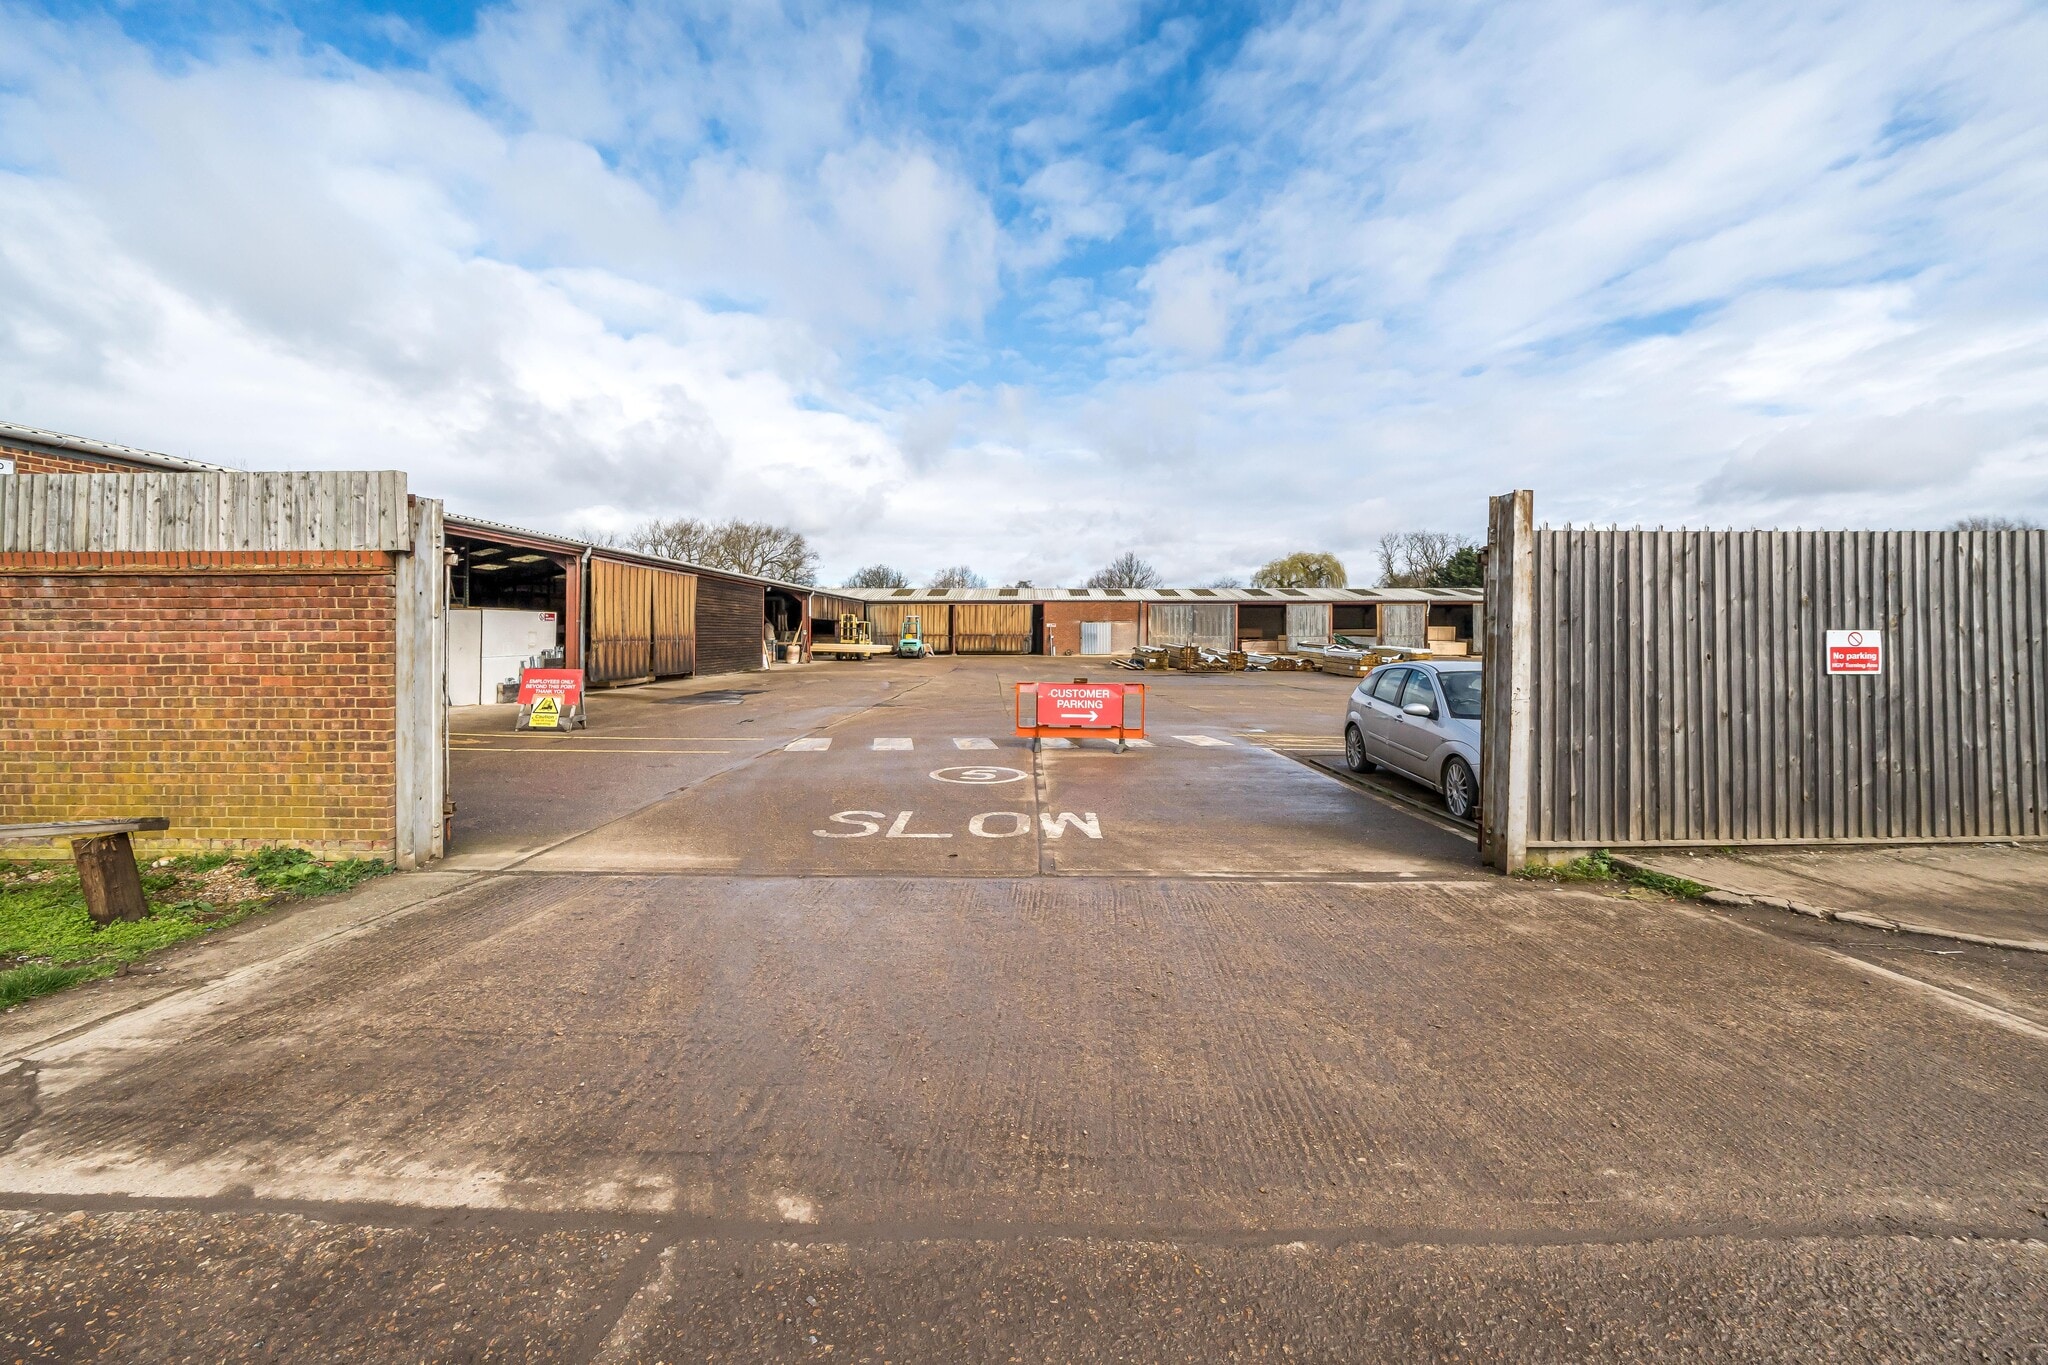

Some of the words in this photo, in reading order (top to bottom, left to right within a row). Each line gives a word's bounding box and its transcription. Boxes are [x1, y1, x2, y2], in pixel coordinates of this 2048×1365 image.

[1833, 652, 1844, 660] No
[1846, 652, 1877, 661] parking
[1050, 688, 1110, 698] CUSTOMER
[1056, 699, 1103, 709] PARKING
[812, 810, 1104, 839] SLOW
